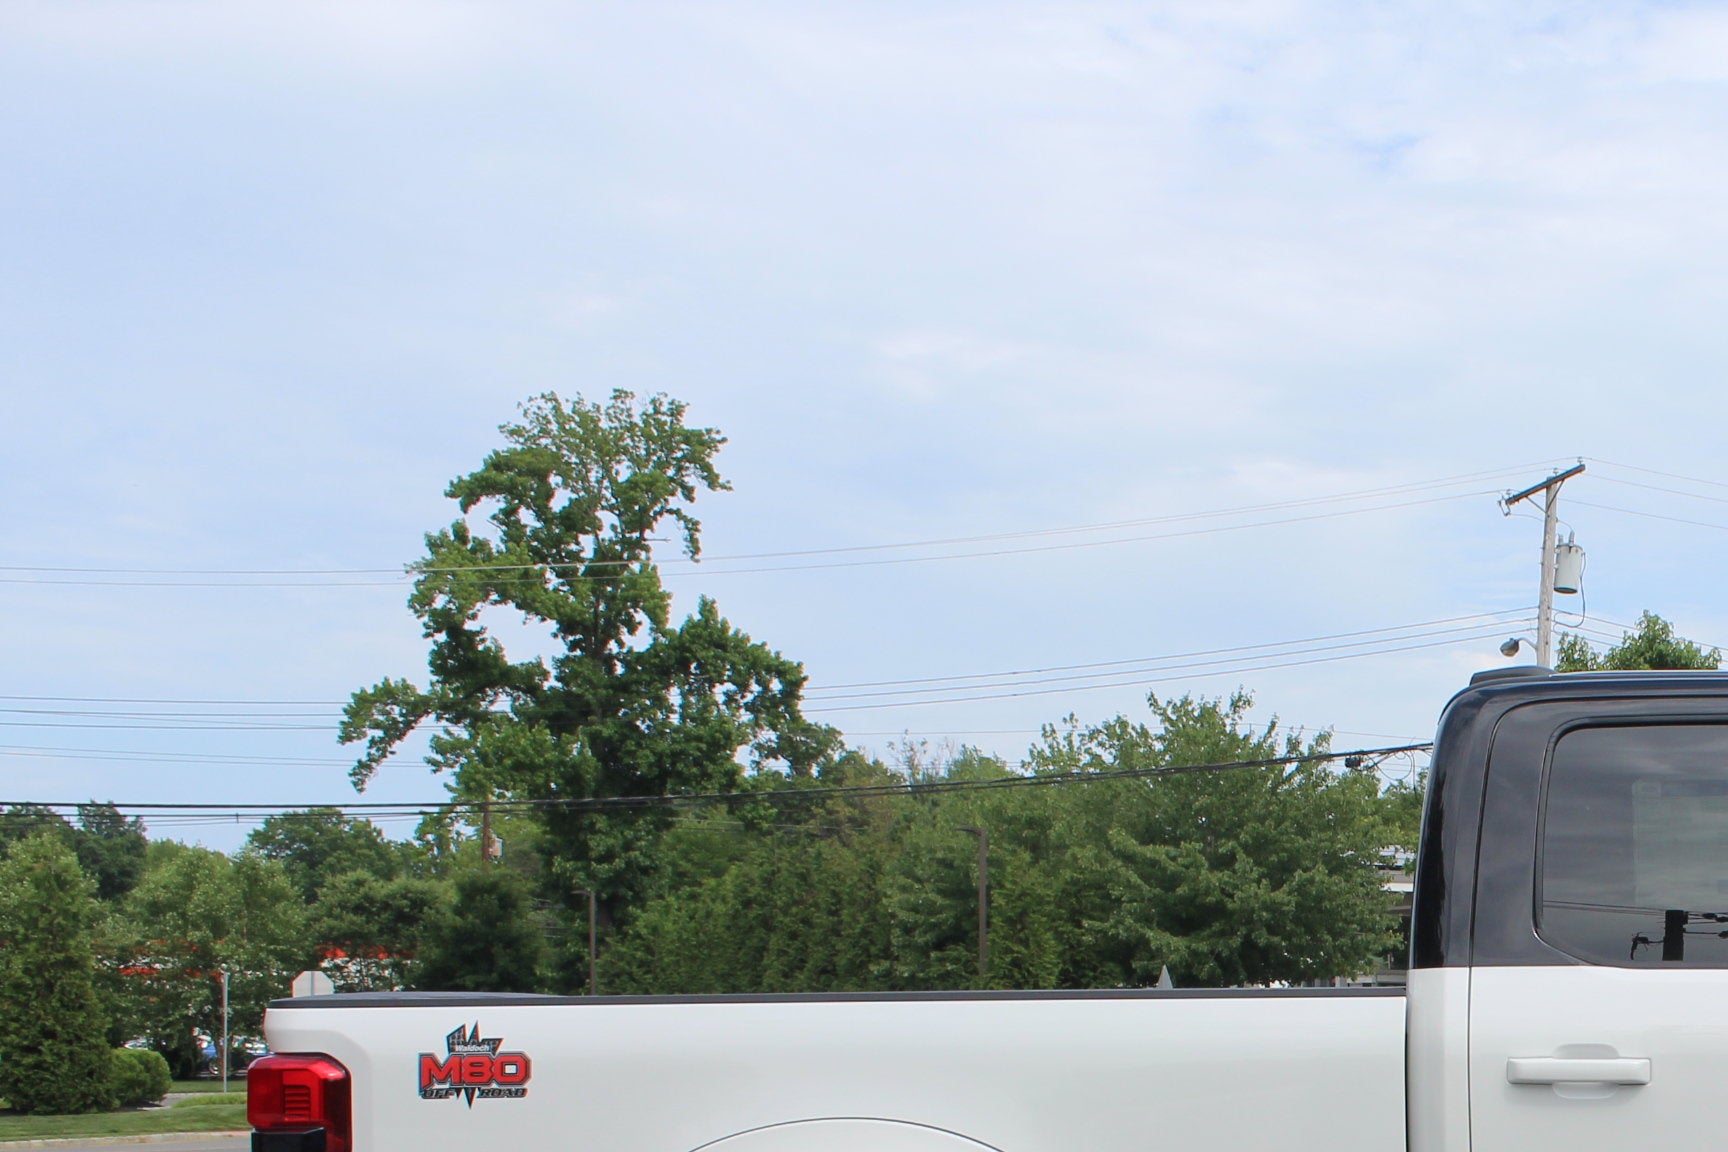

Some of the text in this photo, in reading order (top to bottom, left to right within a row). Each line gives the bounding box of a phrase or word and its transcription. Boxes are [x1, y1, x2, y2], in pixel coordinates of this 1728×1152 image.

[419, 1052, 531, 1088] M80
[423, 1087, 528, 1098] OFF ROAD
